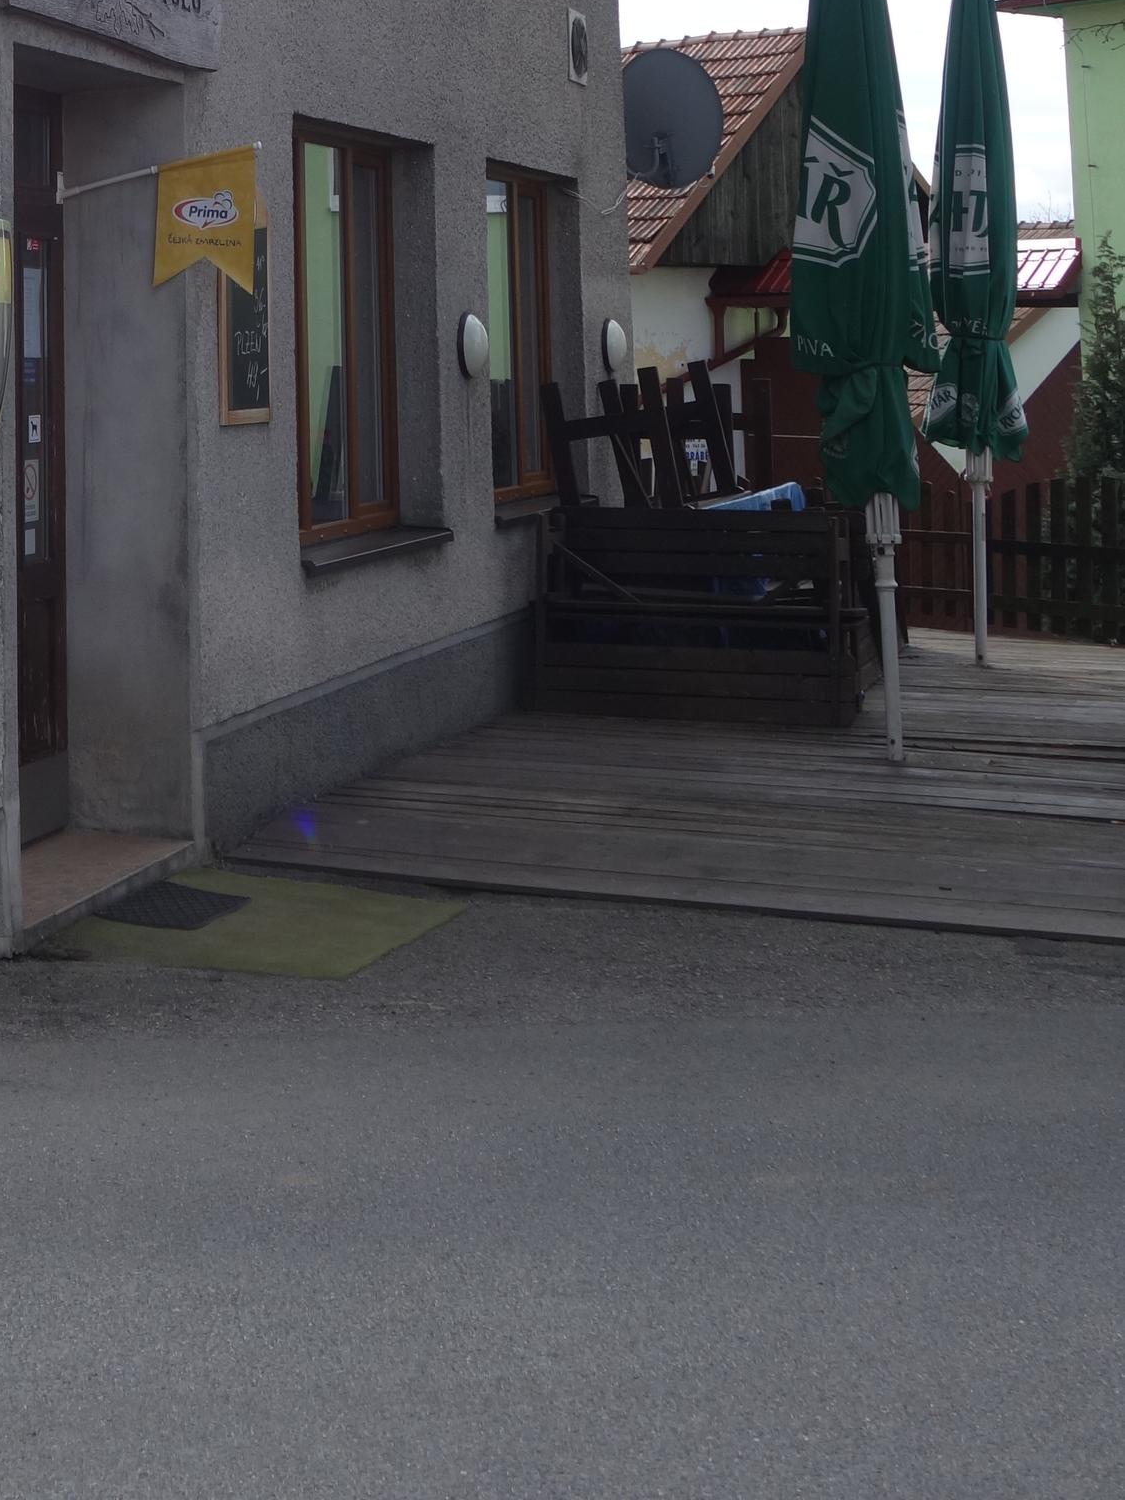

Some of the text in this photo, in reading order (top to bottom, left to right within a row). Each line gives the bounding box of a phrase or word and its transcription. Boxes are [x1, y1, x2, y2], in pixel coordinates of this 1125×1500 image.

[188, 204, 229, 219] Prima
[194, 237, 242, 247] ZMRZLINA
[797, 333, 835, 357] PIVA
